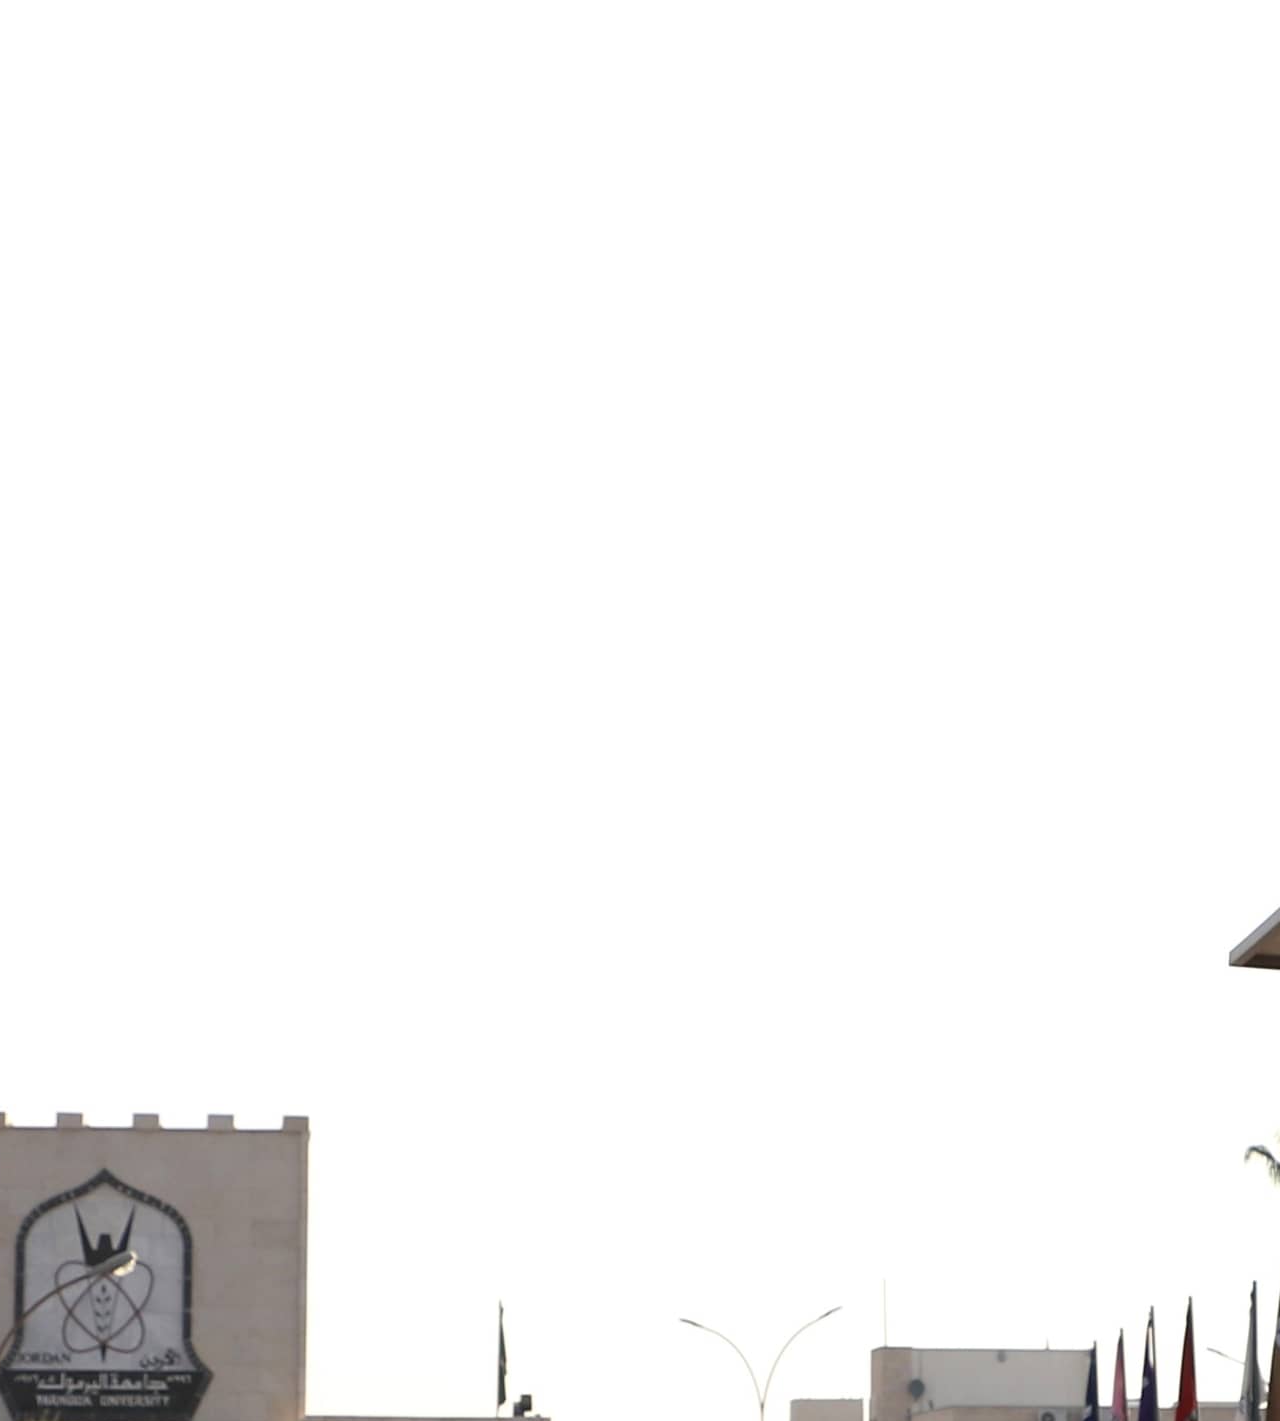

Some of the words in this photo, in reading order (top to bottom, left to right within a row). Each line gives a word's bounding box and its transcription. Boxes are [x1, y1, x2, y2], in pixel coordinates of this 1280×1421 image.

[36, 1372, 108, 1395] اليرموك
[111, 1372, 169, 1395] جامعة
[99, 1394, 170, 1407] UNIVERSITY
